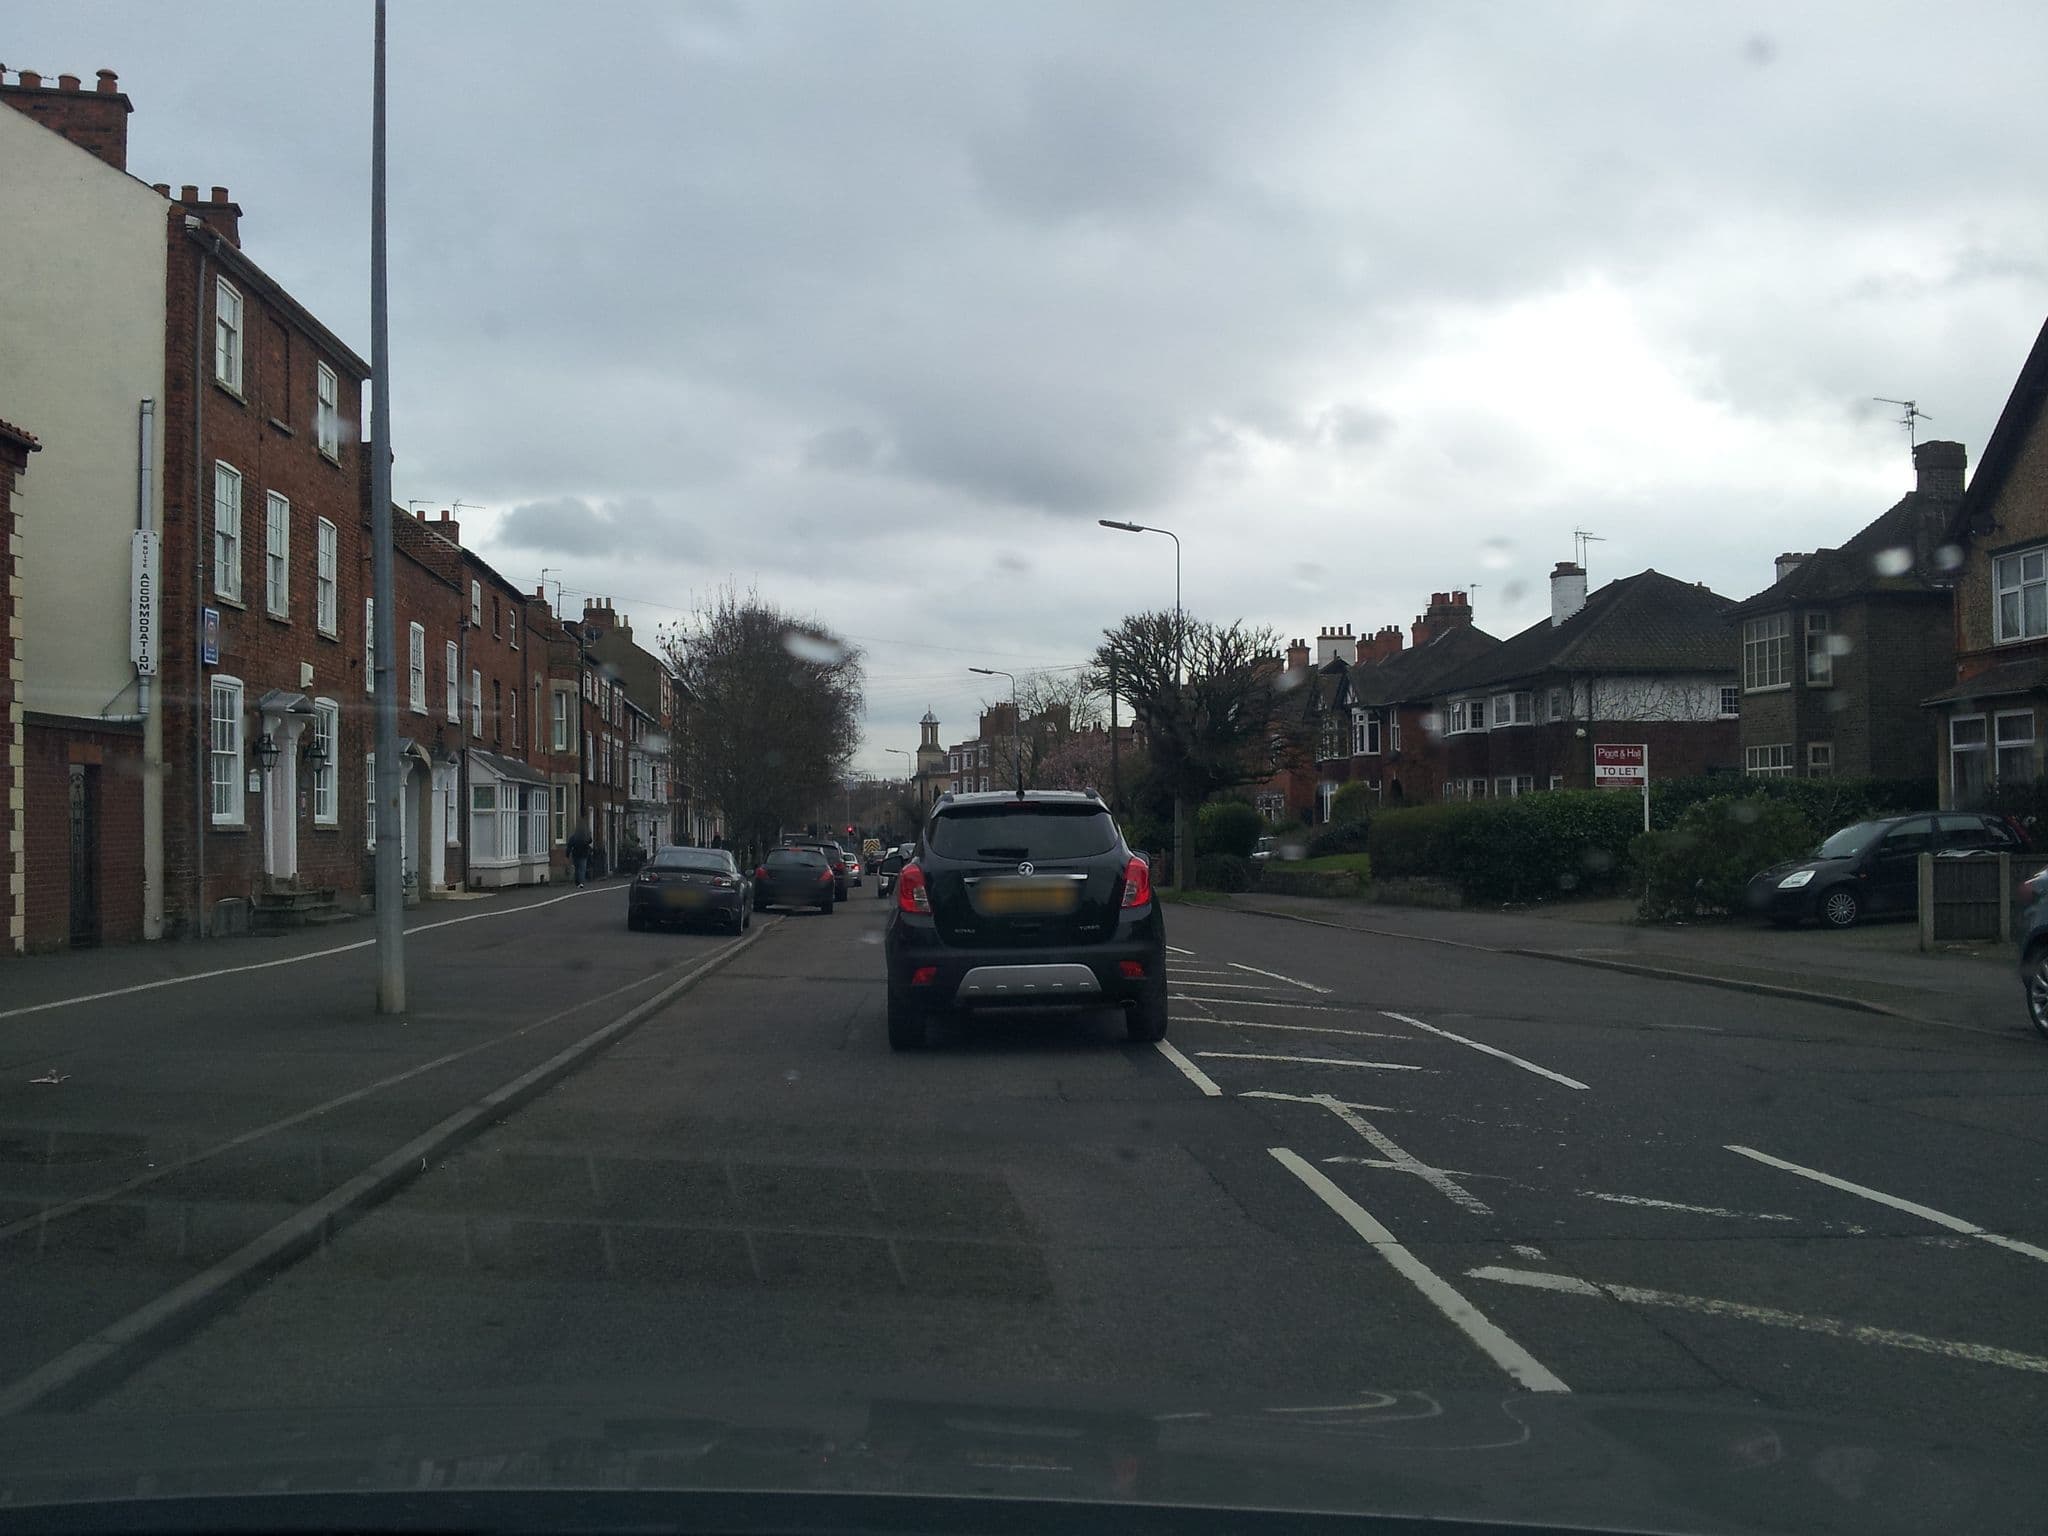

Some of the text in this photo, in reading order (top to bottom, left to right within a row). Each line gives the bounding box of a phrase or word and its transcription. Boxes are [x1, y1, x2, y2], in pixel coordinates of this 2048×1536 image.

[139, 573, 151, 671] ACCOMMODATION
[1602, 767, 1638, 776] TO LET
